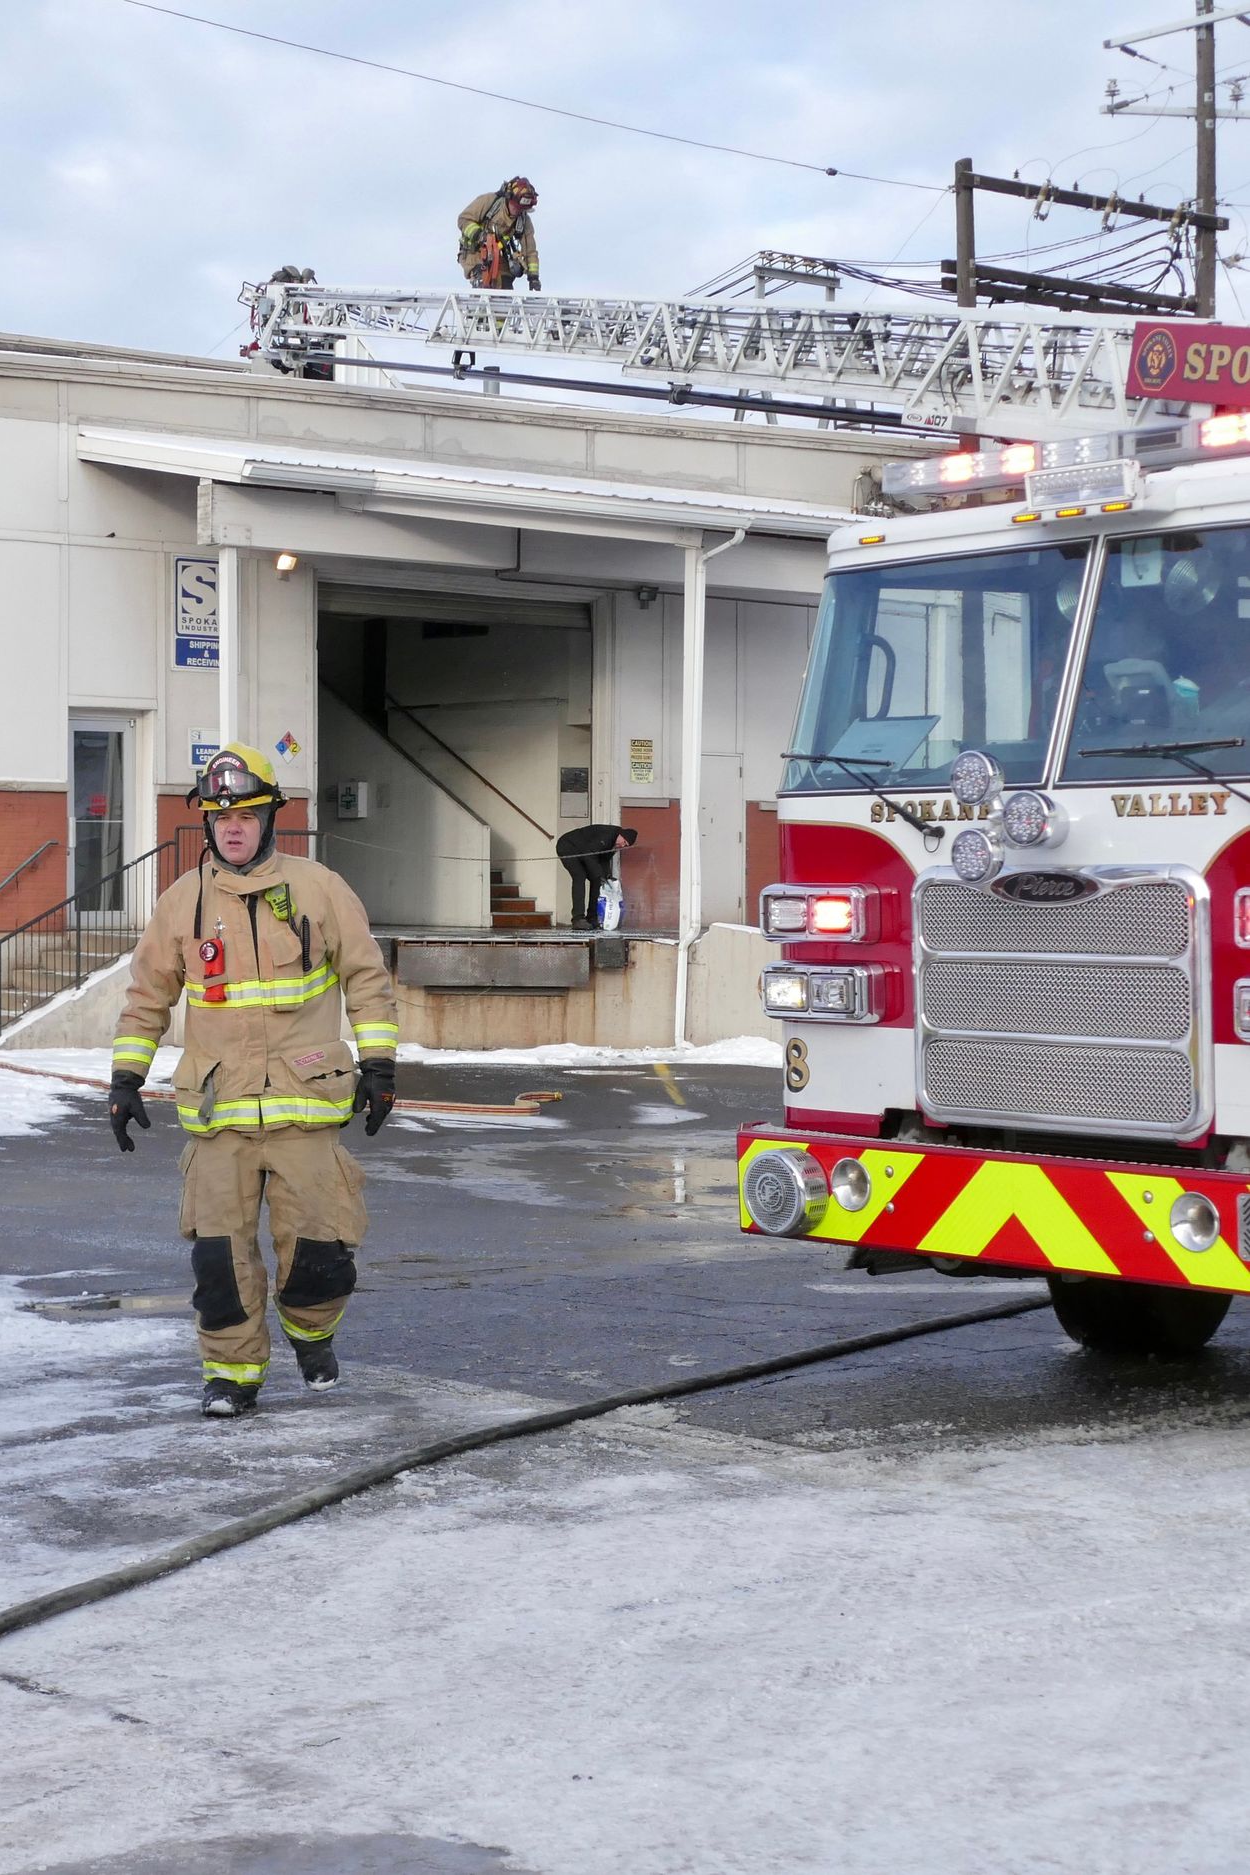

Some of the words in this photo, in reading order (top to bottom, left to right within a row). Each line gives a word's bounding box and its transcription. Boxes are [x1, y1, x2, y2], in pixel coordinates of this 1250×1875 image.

[181, 616, 218, 626] SPOKA
[181, 625, 218, 633] INDUSTR
[189, 640, 219, 650] SHIPPIN
[186, 657, 219, 667] RECEIVIN
[212, 756, 241, 769] ENGINEER
[1111, 791, 1231, 818] VALLEY
[1013, 874, 1076, 898] Pierce
[786, 1037, 810, 1093] 8
